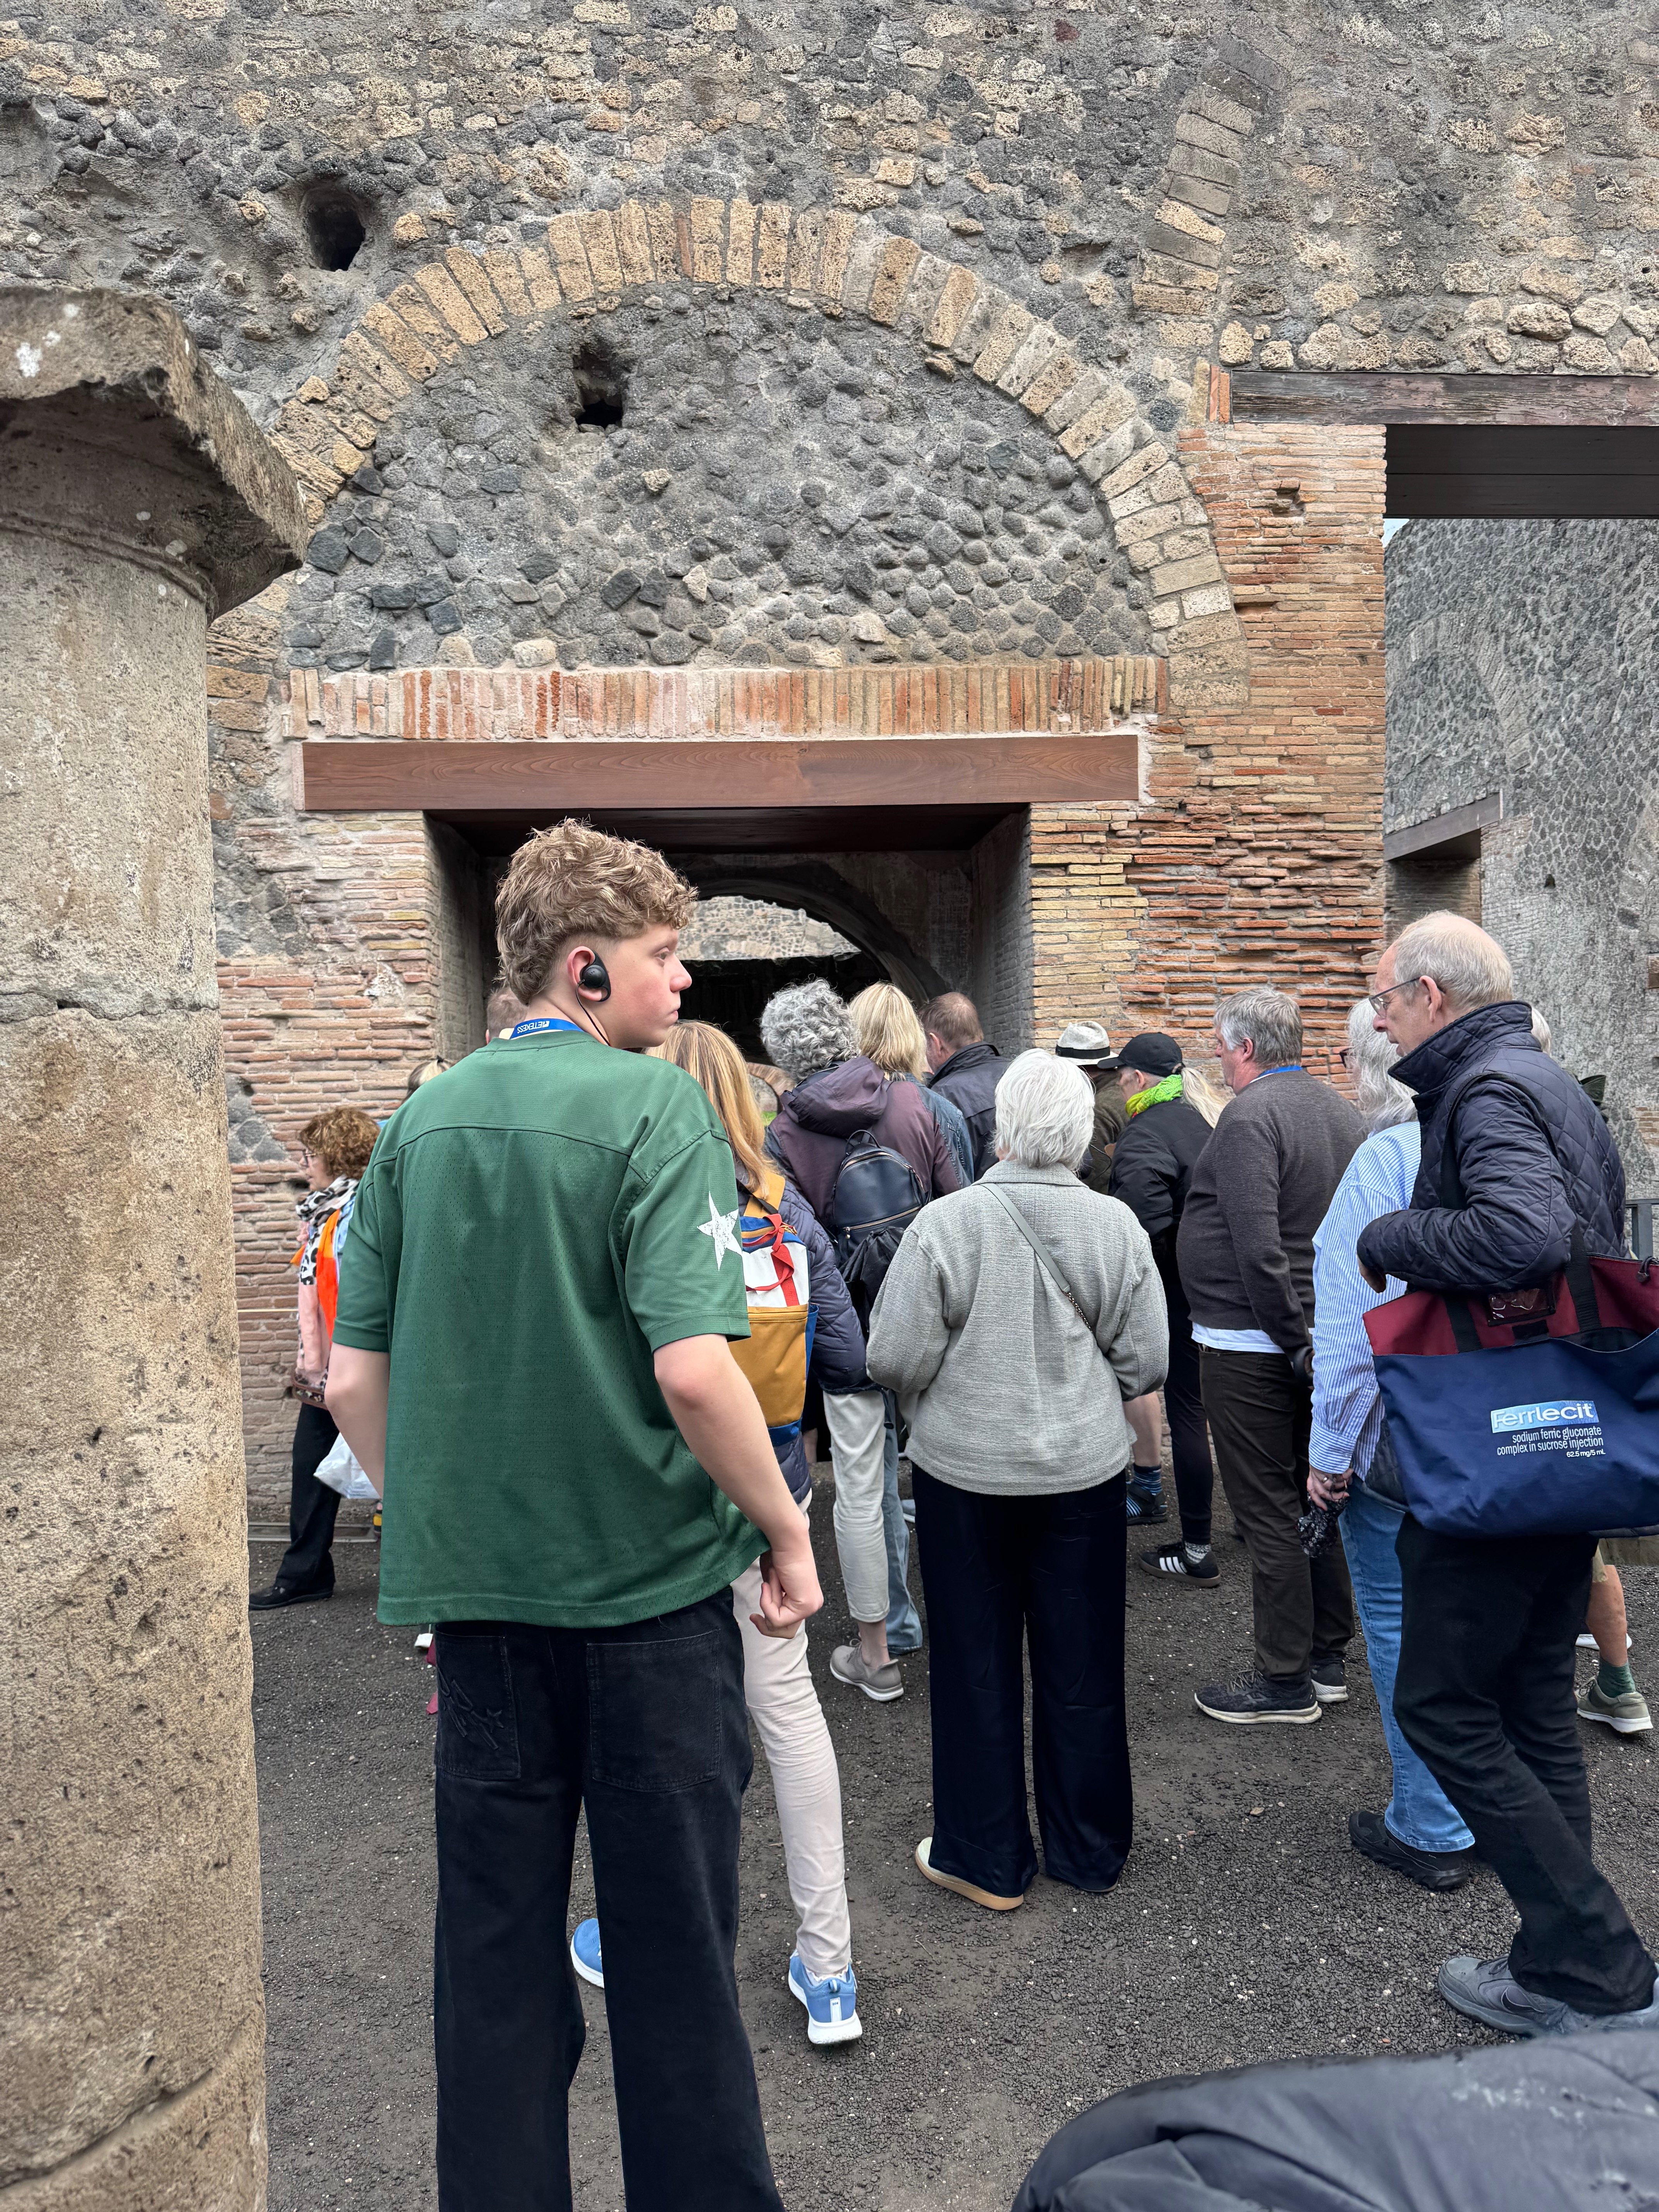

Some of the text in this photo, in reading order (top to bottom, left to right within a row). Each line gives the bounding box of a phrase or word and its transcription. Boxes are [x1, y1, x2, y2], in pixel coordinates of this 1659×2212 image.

[1494, 1403, 1594, 1429] Ferrlecit
[1512, 1425, 1602, 1443] sodium ferric gluconate
[1497, 1436, 1604, 1456] complex in sucrose injection
